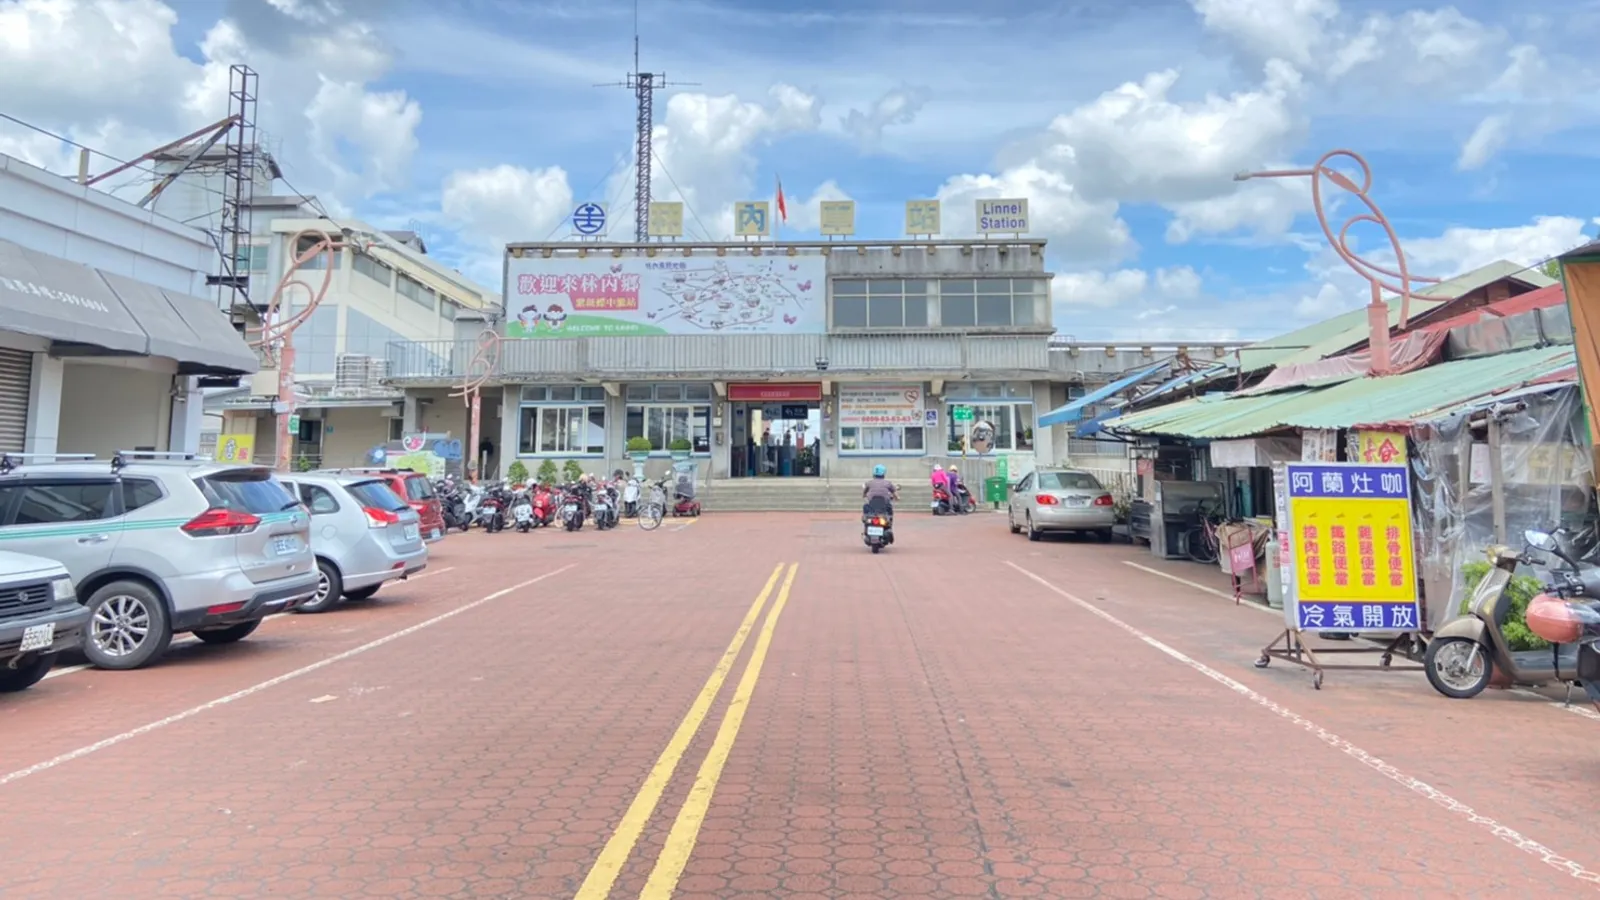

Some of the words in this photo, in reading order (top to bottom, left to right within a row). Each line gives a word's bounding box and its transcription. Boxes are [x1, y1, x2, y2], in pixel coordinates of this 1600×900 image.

[983, 203, 1022, 215] Linnei
[980, 217, 1026, 229] Station
[518, 274, 640, 294] 歡迎來林內鄉
[1291, 471, 1403, 494] 阿蘭灶咖
[1386, 526, 1403, 586] 排骨便當
[1302, 604, 1414, 627] 冷氣開放
